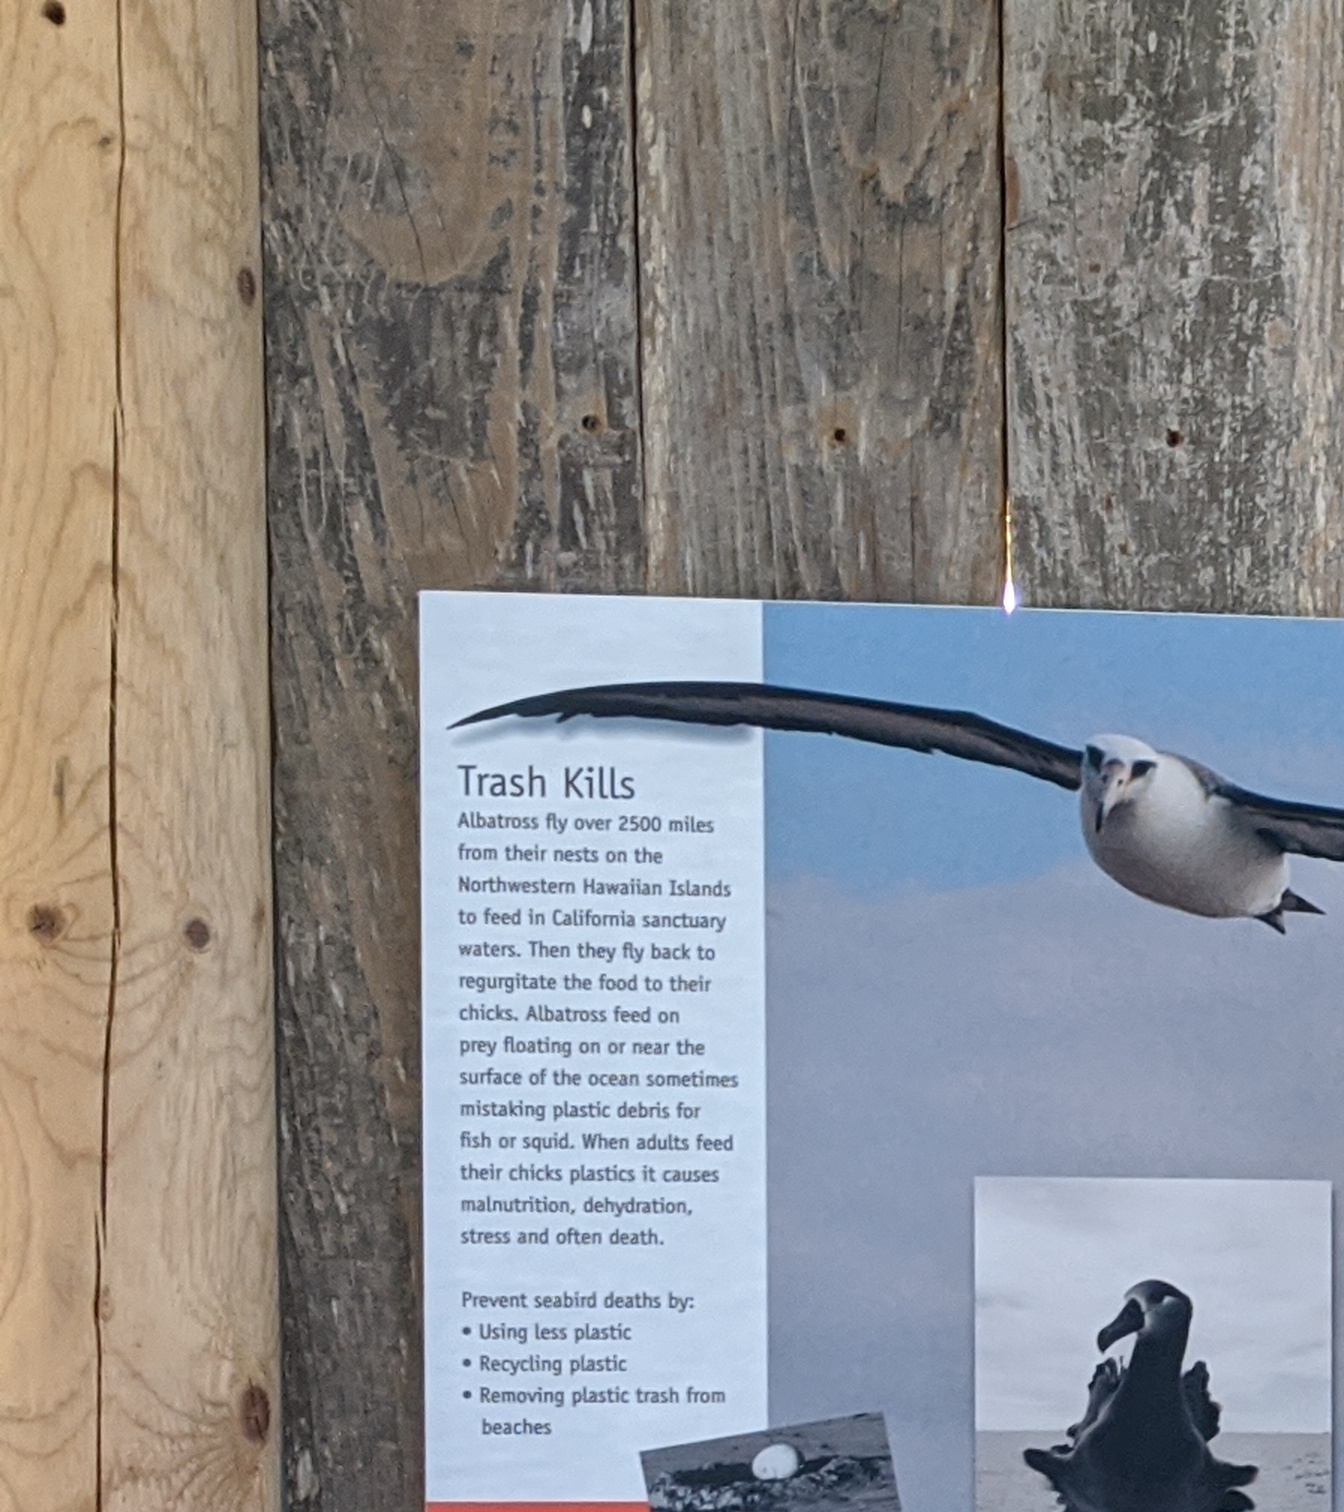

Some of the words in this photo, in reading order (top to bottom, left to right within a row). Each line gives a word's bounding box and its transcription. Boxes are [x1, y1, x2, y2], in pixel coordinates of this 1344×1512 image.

[458, 765, 546, 798] Trash
[565, 767, 635, 799] Kills
[458, 811, 539, 830] Albatross
[546, 812, 568, 834] fly
[574, 817, 612, 831] over
[619, 816, 662, 832] 2500
[669, 815, 714, 834] miles
[458, 843, 497, 860] from
[505, 844, 547, 862] their
[554, 847, 599, 863] nests
[605, 850, 627, 863] on
[634, 847, 663, 864] the
[459, 876, 575, 895] Northwestern
[583, 878, 662, 896] Hawaiian
[669, 879, 731, 898] Islands
[458, 909, 477, 925] to
[483, 907, 521, 926] feed
[528, 908, 545, 925] in
[552, 909, 636, 927] California
[642, 913, 726, 933] sanctuary
[459, 942, 521, 957] waters.
[528, 940, 570, 958] Then
[577, 941, 616, 963] they
[622, 942, 644, 964] fly
[651, 943, 690, 960] back
[697, 944, 715, 961] to
[459, 972, 557, 994] regurgitate
[563, 973, 592, 991] the
[599, 973, 638, 991] food
[644, 976, 663, 992] to
[669, 975, 711, 992] their
[459, 1004, 518, 1021] chicks.
[526, 1004, 607, 1023] Albatross
[613, 1006, 651, 1023] feed
[658, 1011, 679, 1024] on
[460, 1039, 497, 1057] prey
[503, 1036, 572, 1058] floating
[579, 1042, 600, 1054] on
[608, 1042, 626, 1055] or
[632, 1042, 670, 1055] near
[676, 1039, 705, 1056] the
[460, 1068, 522, 1085] surface
[529, 1068, 547, 1085] of
[553, 1068, 581, 1086] the
[588, 1074, 639, 1087] ocean
[646, 1070, 738, 1088] sometimes
[461, 1099, 546, 1122] mistaking
[553, 1100, 610, 1122] plastic
[617, 1101, 670, 1119] debris
[676, 1102, 700, 1119] for
[460, 1131, 491, 1148] fish
[499, 1136, 516, 1148] or
[523, 1132, 575, 1153] squid.
[582, 1133, 629, 1150] When
[636, 1133, 689, 1151] adults
[696, 1133, 733, 1151] feed
[460, 1163, 503, 1181] their
[509, 1163, 563, 1181] chicks
[570, 1164, 635, 1185] plastics
[642, 1165, 656, 1182] it
[662, 1170, 719, 1183] causes
[461, 1196, 575, 1215] malnutrition,
[583, 1197, 692, 1218] dehydration,
[461, 1228, 511, 1244] stress
[517, 1228, 549, 1245] and
[556, 1227, 602, 1245] often
[609, 1228, 664, 1245] death.
[462, 1291, 528, 1308] Prevent
[534, 1291, 597, 1308] seabird
[604, 1291, 661, 1309] deaths
[668, 1292, 694, 1313] by:
[479, 1323, 527, 1345] Using
[535, 1323, 567, 1340] less
[574, 1323, 631, 1344] plastic
[480, 1355, 562, 1377] Recycling
[570, 1355, 627, 1376] plastic
[480, 1386, 564, 1407] Removing
[572, 1386, 629, 1407] plastic
[635, 1386, 679, 1403] trash
[686, 1386, 725, 1403] from
[482, 1418, 552, 1434] beaches
